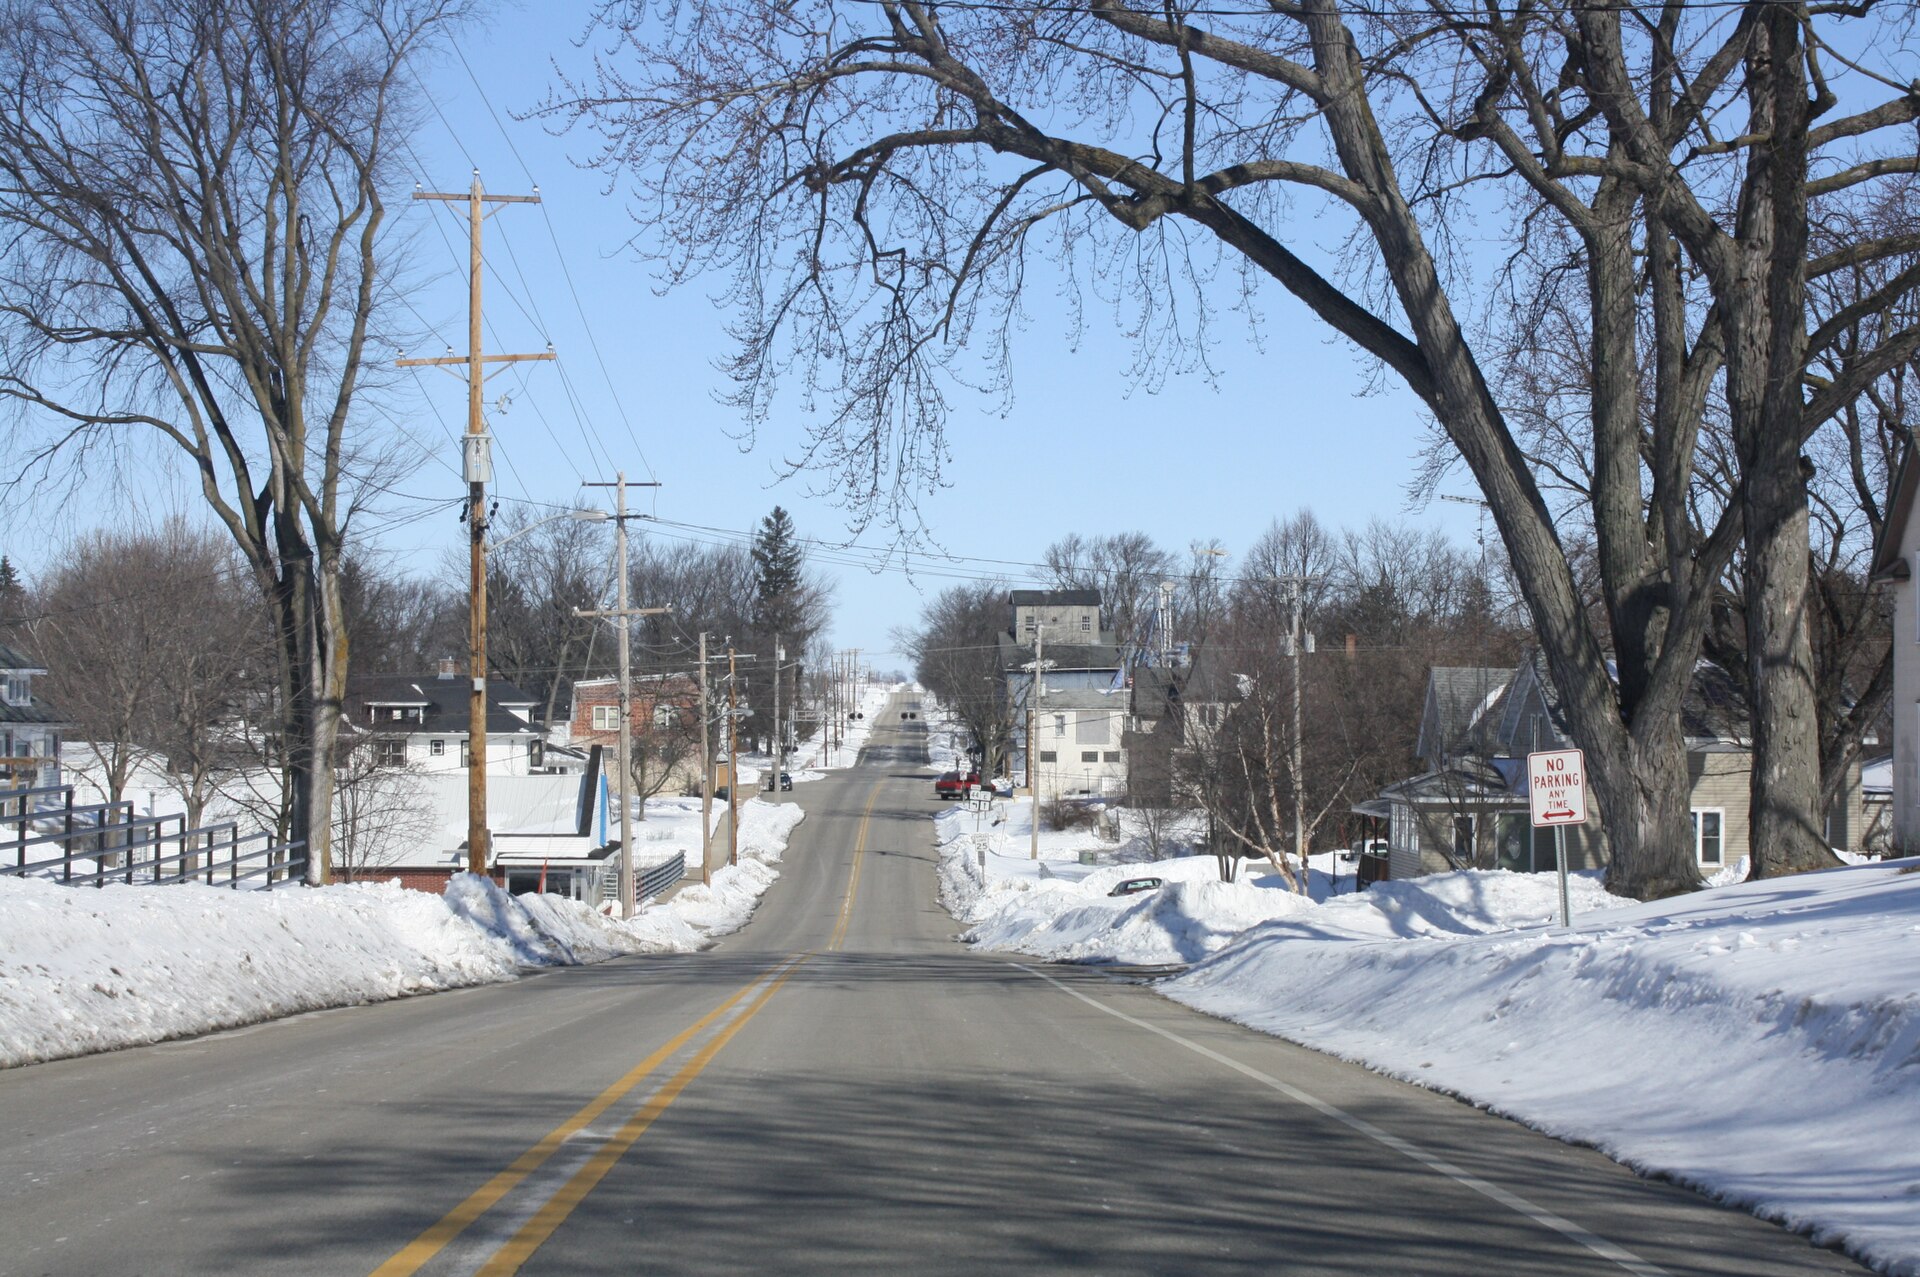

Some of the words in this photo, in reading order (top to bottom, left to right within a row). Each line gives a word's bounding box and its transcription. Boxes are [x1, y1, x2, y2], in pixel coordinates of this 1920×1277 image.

[1546, 758, 1564, 772] NO
[1534, 773, 1579, 789] PARKING
[1549, 790, 1566, 799] ANY
[1548, 800, 1568, 809] TIME
[976, 842, 988, 850] 25
